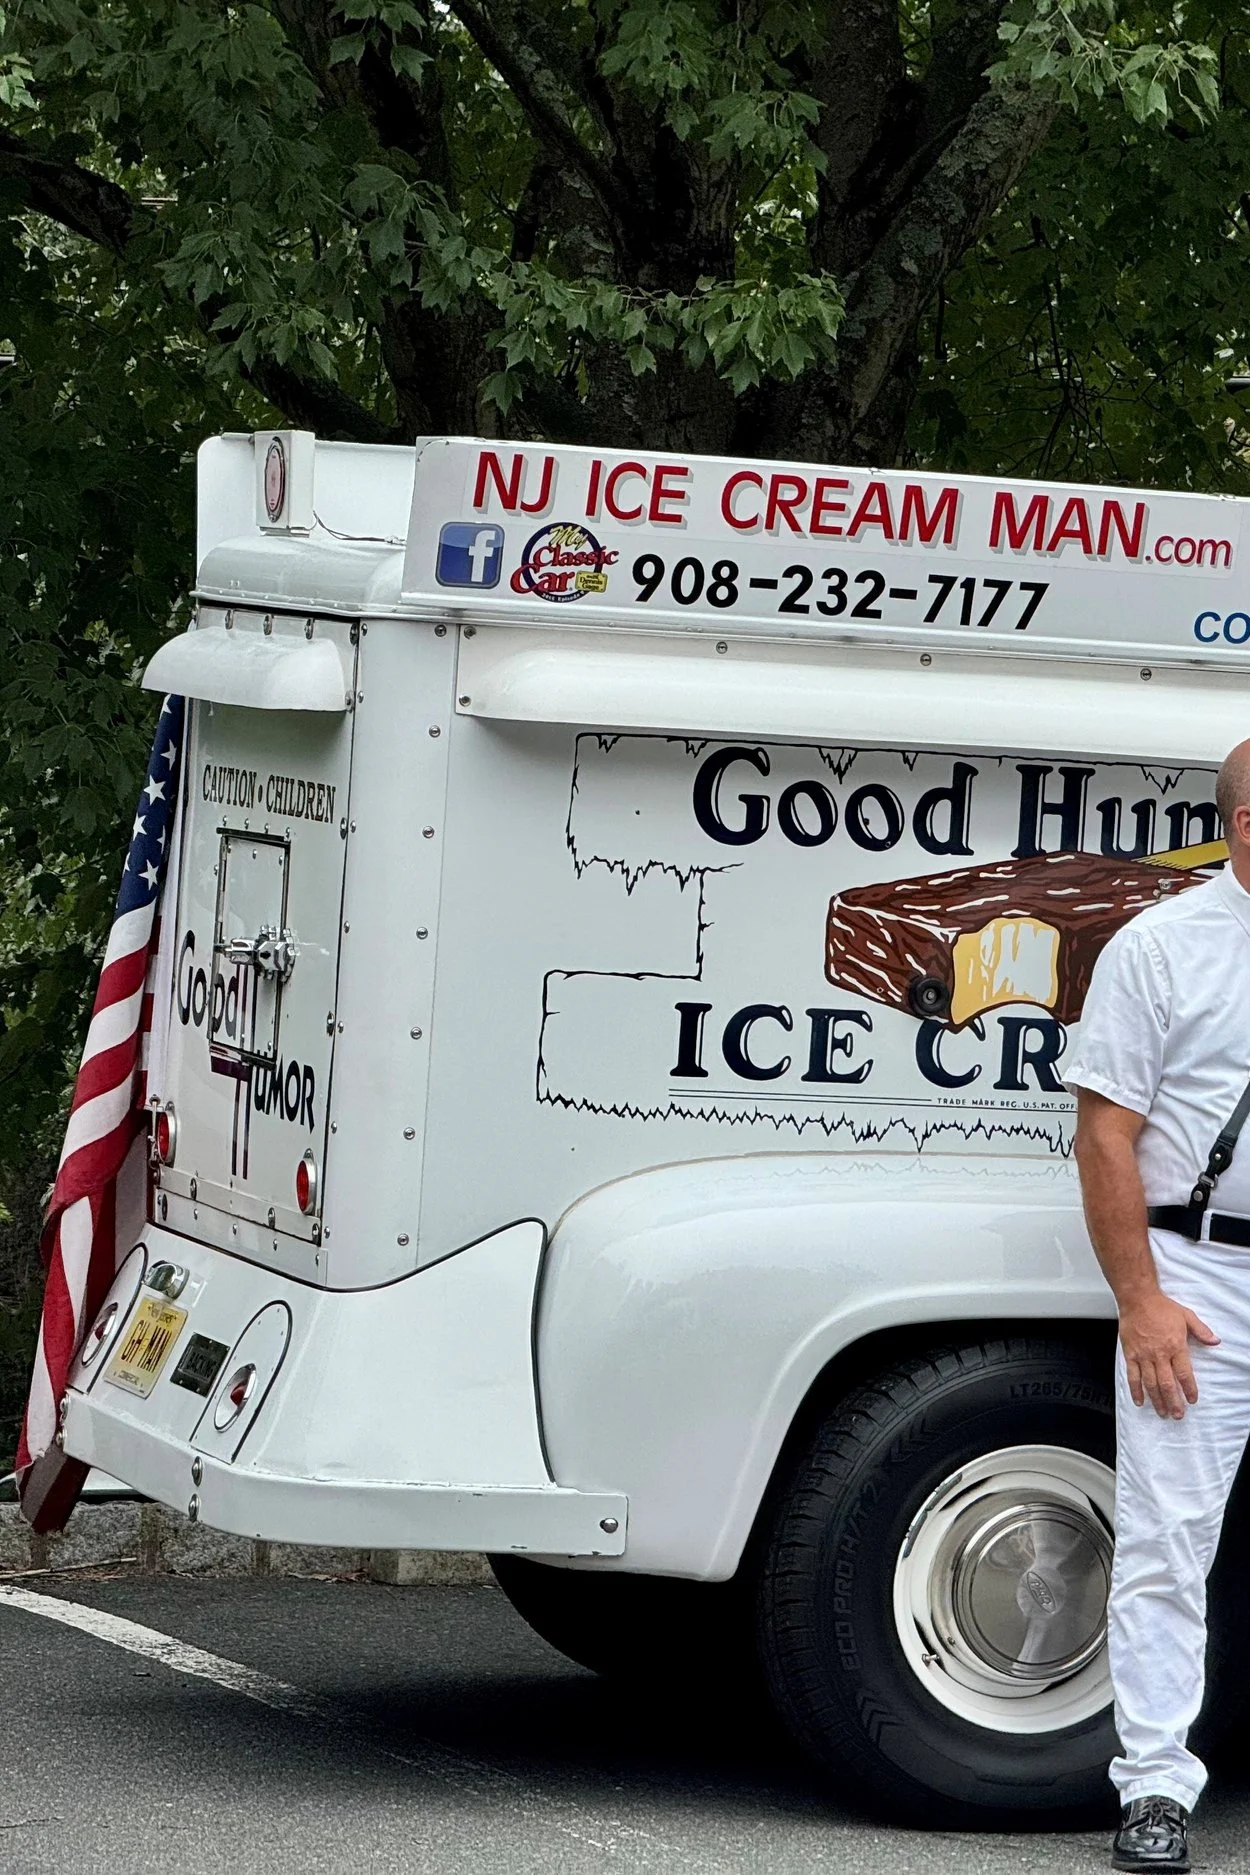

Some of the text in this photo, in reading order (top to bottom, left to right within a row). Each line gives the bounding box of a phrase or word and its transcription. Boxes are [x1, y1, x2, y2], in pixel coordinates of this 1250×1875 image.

[474, 451, 554, 514] NJ
[586, 460, 690, 524] ICE
[721, 470, 961, 546] CREAM
[533, 545, 619, 567] Classic
[549, 525, 587, 549] My
[510, 563, 575, 594] Car
[633, 553, 1050, 630] 908-232-7177
[203, 764, 336, 824] CAUTION CHILDREN
[692, 746, 980, 857] Good
[669, 1002, 874, 1084] ICE
[937, 1097, 967, 1106] TRADE
[971, 1099, 996, 1107] MARK
